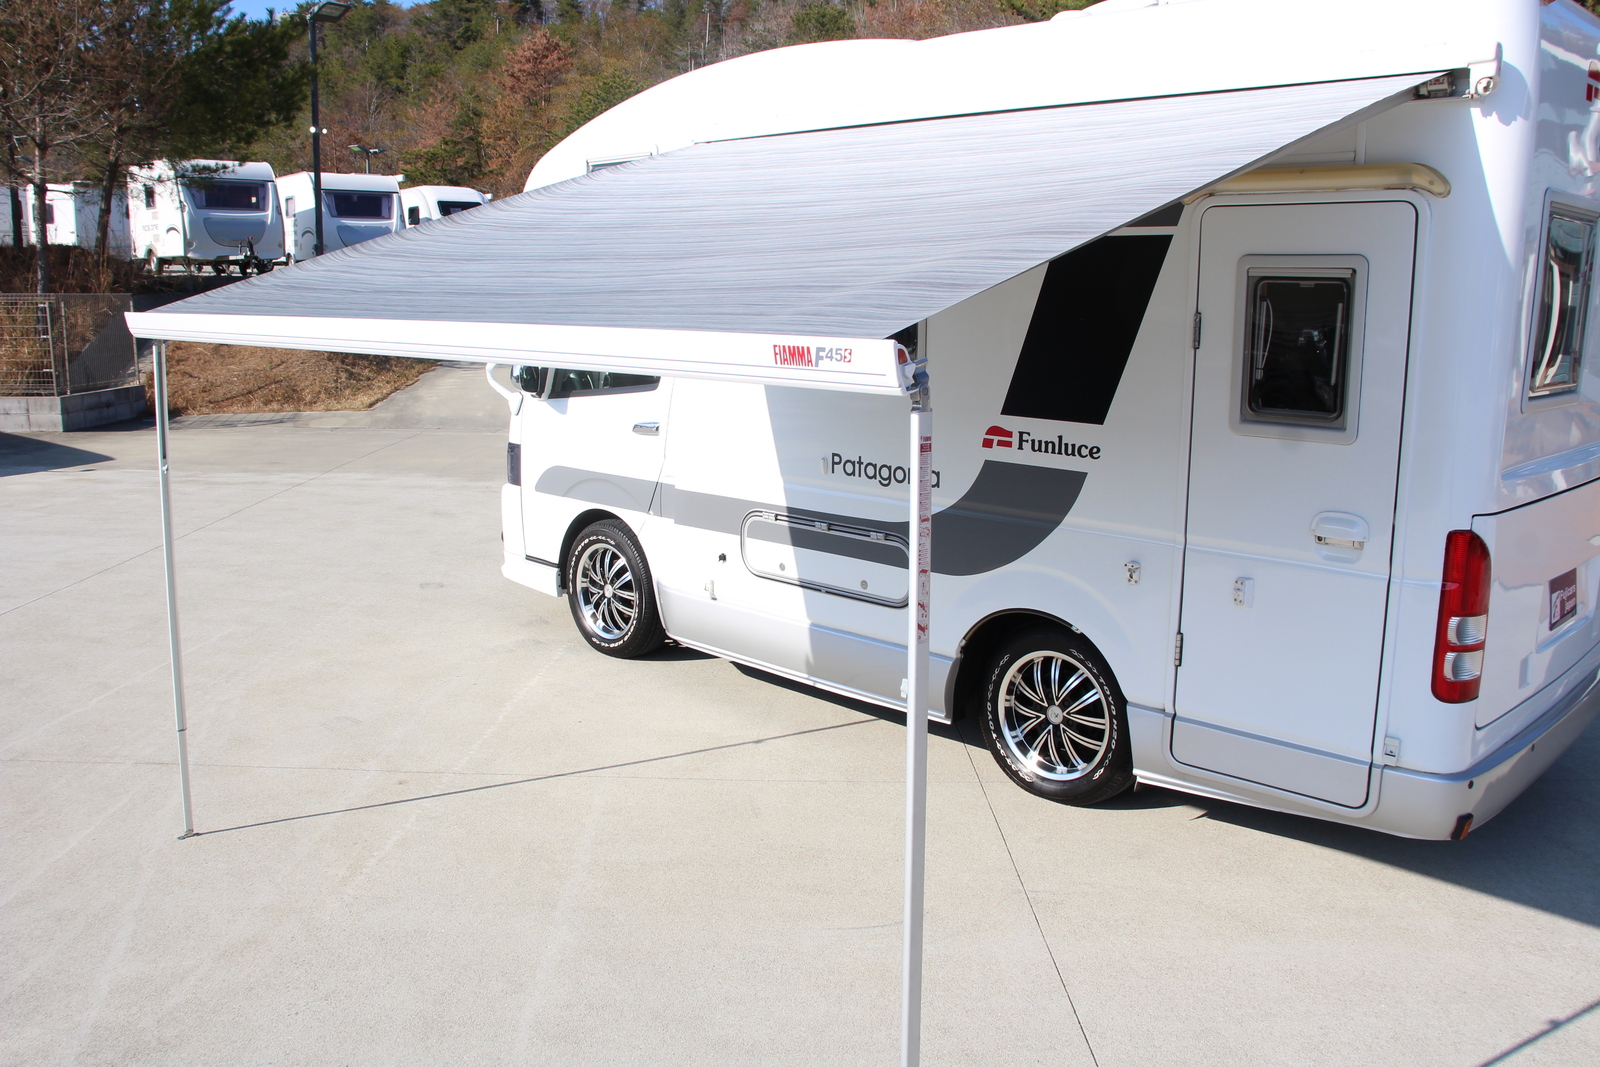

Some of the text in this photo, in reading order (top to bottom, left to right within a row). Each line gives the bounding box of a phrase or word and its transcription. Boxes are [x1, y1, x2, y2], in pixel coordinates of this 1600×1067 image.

[773, 344, 813, 367] FIAMMA
[1017, 431, 1101, 459] Funluce
[831, 452, 940, 488] Patagoa
[1099, 676, 1116, 716] TOYO
